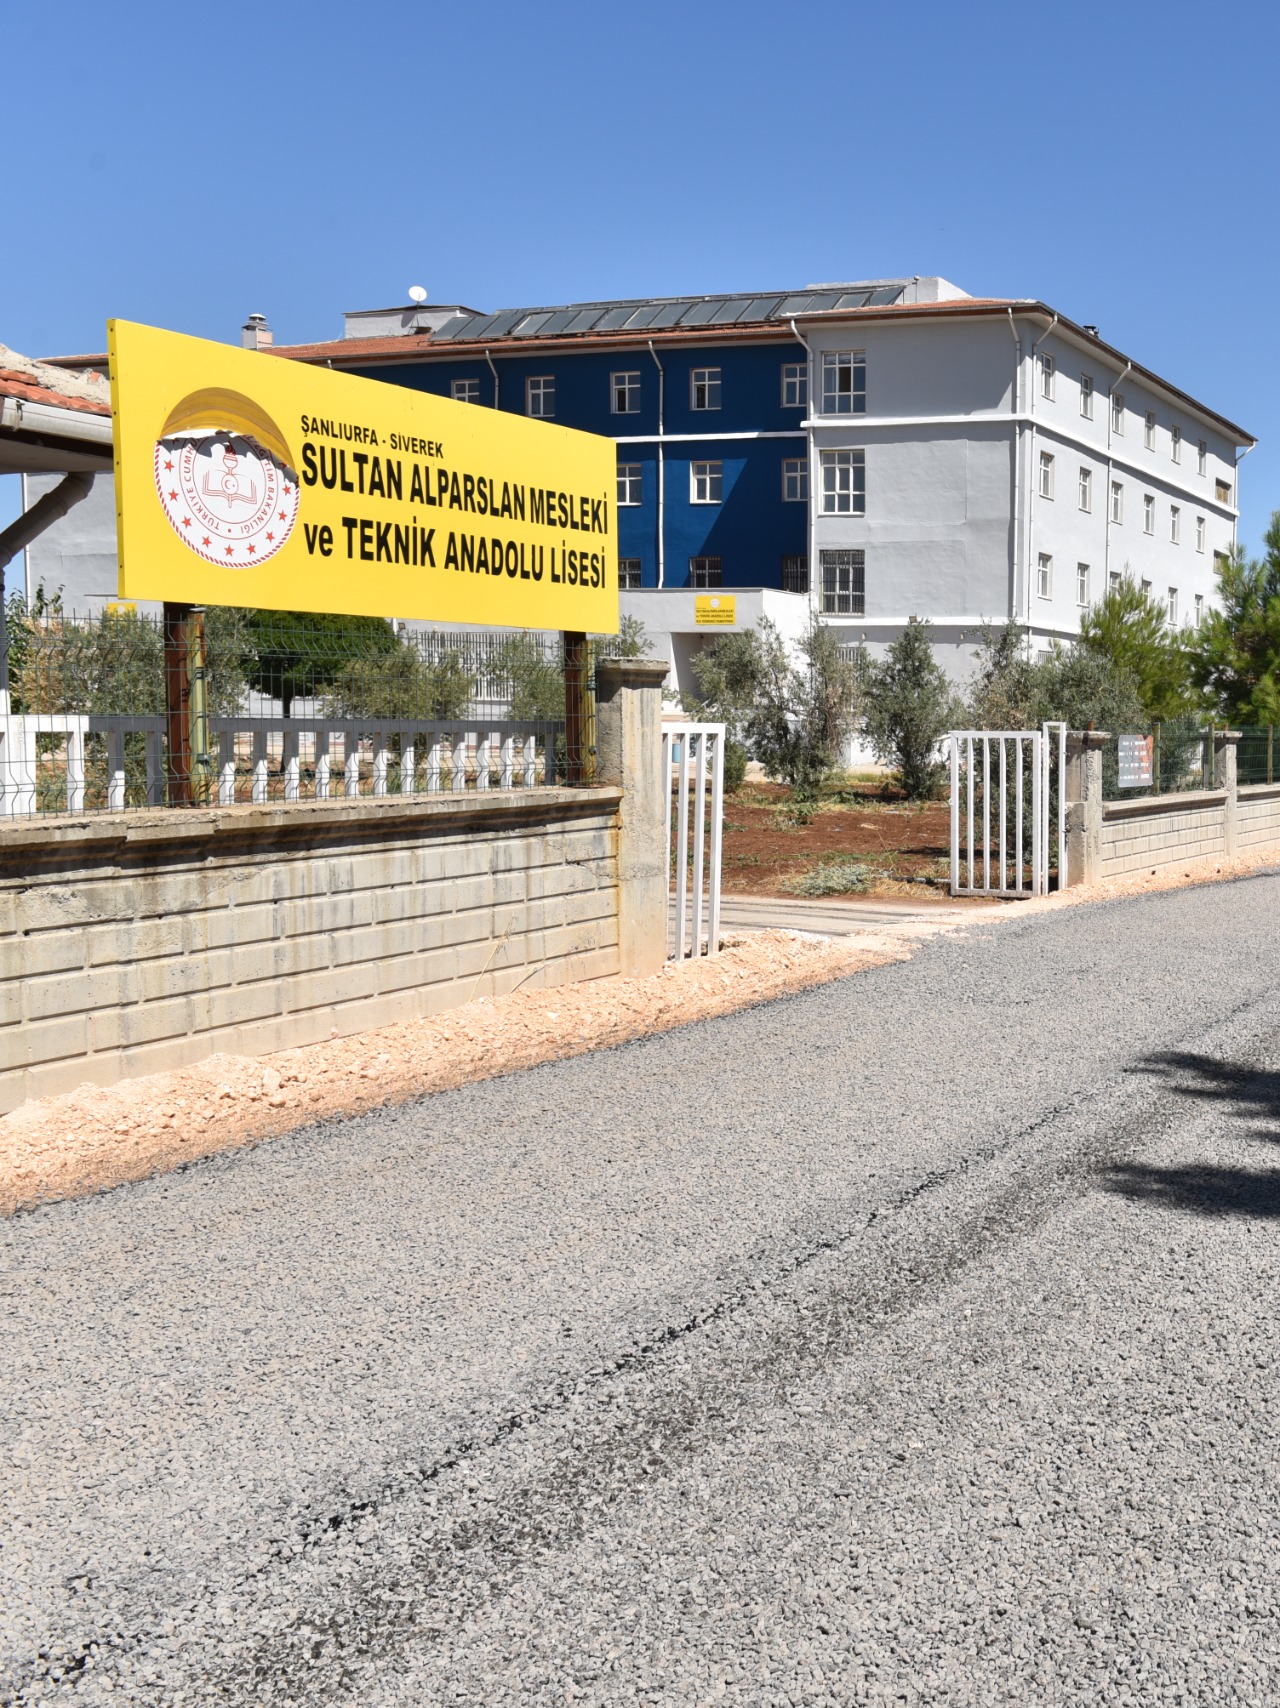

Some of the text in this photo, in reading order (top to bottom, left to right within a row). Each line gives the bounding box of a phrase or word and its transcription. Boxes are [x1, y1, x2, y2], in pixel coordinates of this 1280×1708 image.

[301, 414, 379, 446] ŞANLIURFA
[390, 432, 444, 459] SİVEREK
[186, 487, 220, 531] TÜRKİYE
[240, 487, 275, 535] BAKANLIĞI
[301, 442, 608, 535] SULTAN ALPARSLAN MESLEKİ
[303, 515, 606, 589] ve TEKNİK ANADOLU LİSESİ
